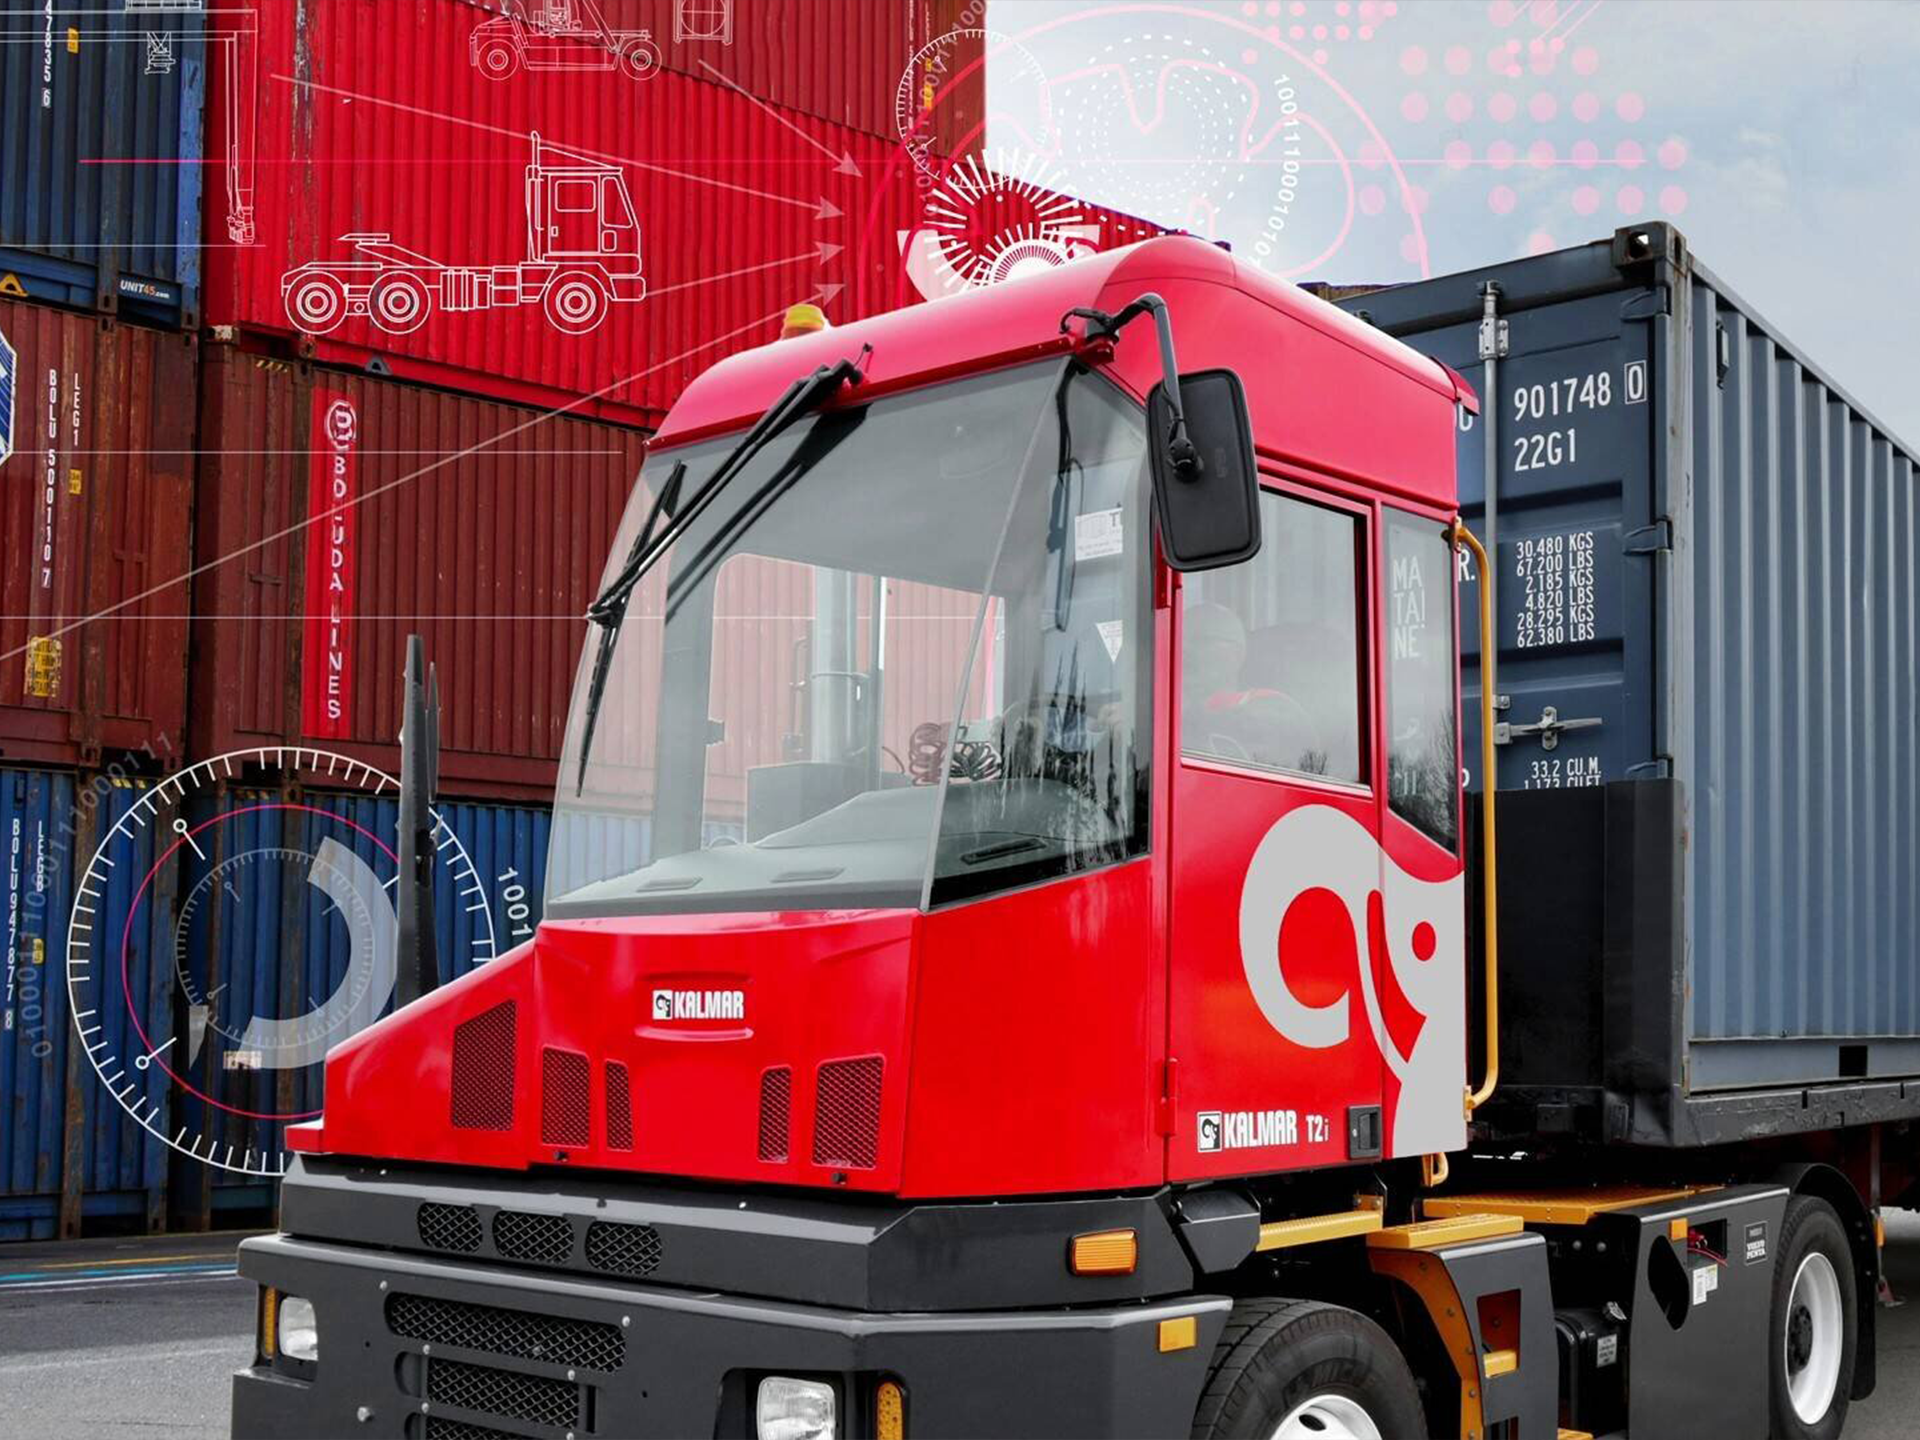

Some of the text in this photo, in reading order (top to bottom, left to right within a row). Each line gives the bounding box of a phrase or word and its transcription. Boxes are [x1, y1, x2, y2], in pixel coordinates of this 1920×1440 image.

[48, 369, 57, 438] BOLU
[1514, 371, 1611, 421] 901748
[1626, 363, 1645, 402] 0
[72, 372, 81, 446] LEG1
[1514, 428, 1576, 471] 22G1
[1516, 531, 1594, 559] 30.480 KGS
[1516, 550, 1594, 576] 67.200 LBS
[41, 567, 51, 588] 7
[1525, 568, 1594, 593] 2.185 KGS
[1525, 586, 1594, 611] 4.820 LBS
[1517, 604, 1594, 630] 28.295 KGS
[1517, 622, 1594, 648] 62.380 LBS
[328, 603, 343, 719] LINES
[1531, 760, 1561, 779] 33.2
[674, 990, 745, 1019] KALMAR
[5, 1009, 13, 1030] 8
[1224, 1110, 1298, 1149] KALMAR
